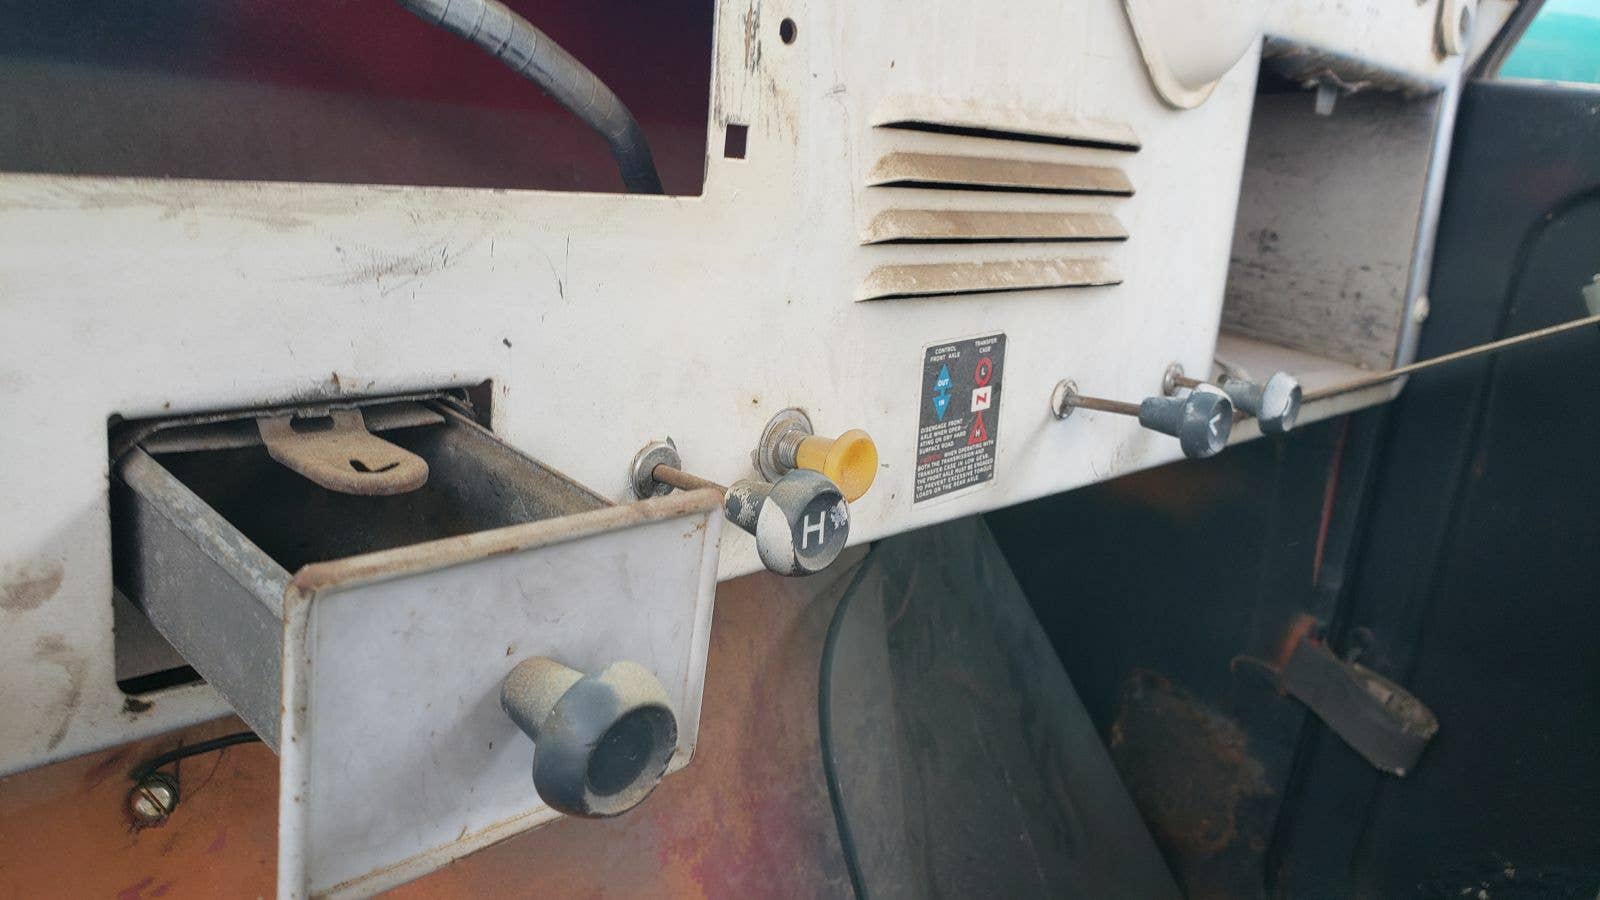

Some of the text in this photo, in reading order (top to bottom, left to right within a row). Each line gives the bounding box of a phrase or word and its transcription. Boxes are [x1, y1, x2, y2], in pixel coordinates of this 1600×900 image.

[975, 337, 997, 346] TRANSFER
[935, 346, 956, 355] CONTROL
[938, 378, 950, 387] OUT
[921, 418, 963, 434] DISENGAGE FRONT
[920, 439, 934, 447] ATING
[954, 431, 966, 439] HARD
[975, 429, 980, 438] H
[919, 445, 940, 455] SURFACE
[958, 444, 982, 454] OPERATING
[942, 452, 974, 464] TRANSMISSION
[917, 467, 942, 478] TRANSFER
[944, 463, 956, 471] CASE
[927, 473, 942, 482] FRONT
[943, 469, 954, 477] AXLE
[955, 466, 966, 474] MUST
[974, 458, 993, 468] ENGAGED
[924, 479, 946, 490] PREVENT
[948, 471, 973, 483] EXCESSIVE
[974, 465, 992, 474] TORQUE
[916, 489, 932, 499] LOADS
[953, 479, 966, 487] REAR
[801, 510, 826, 550] H
